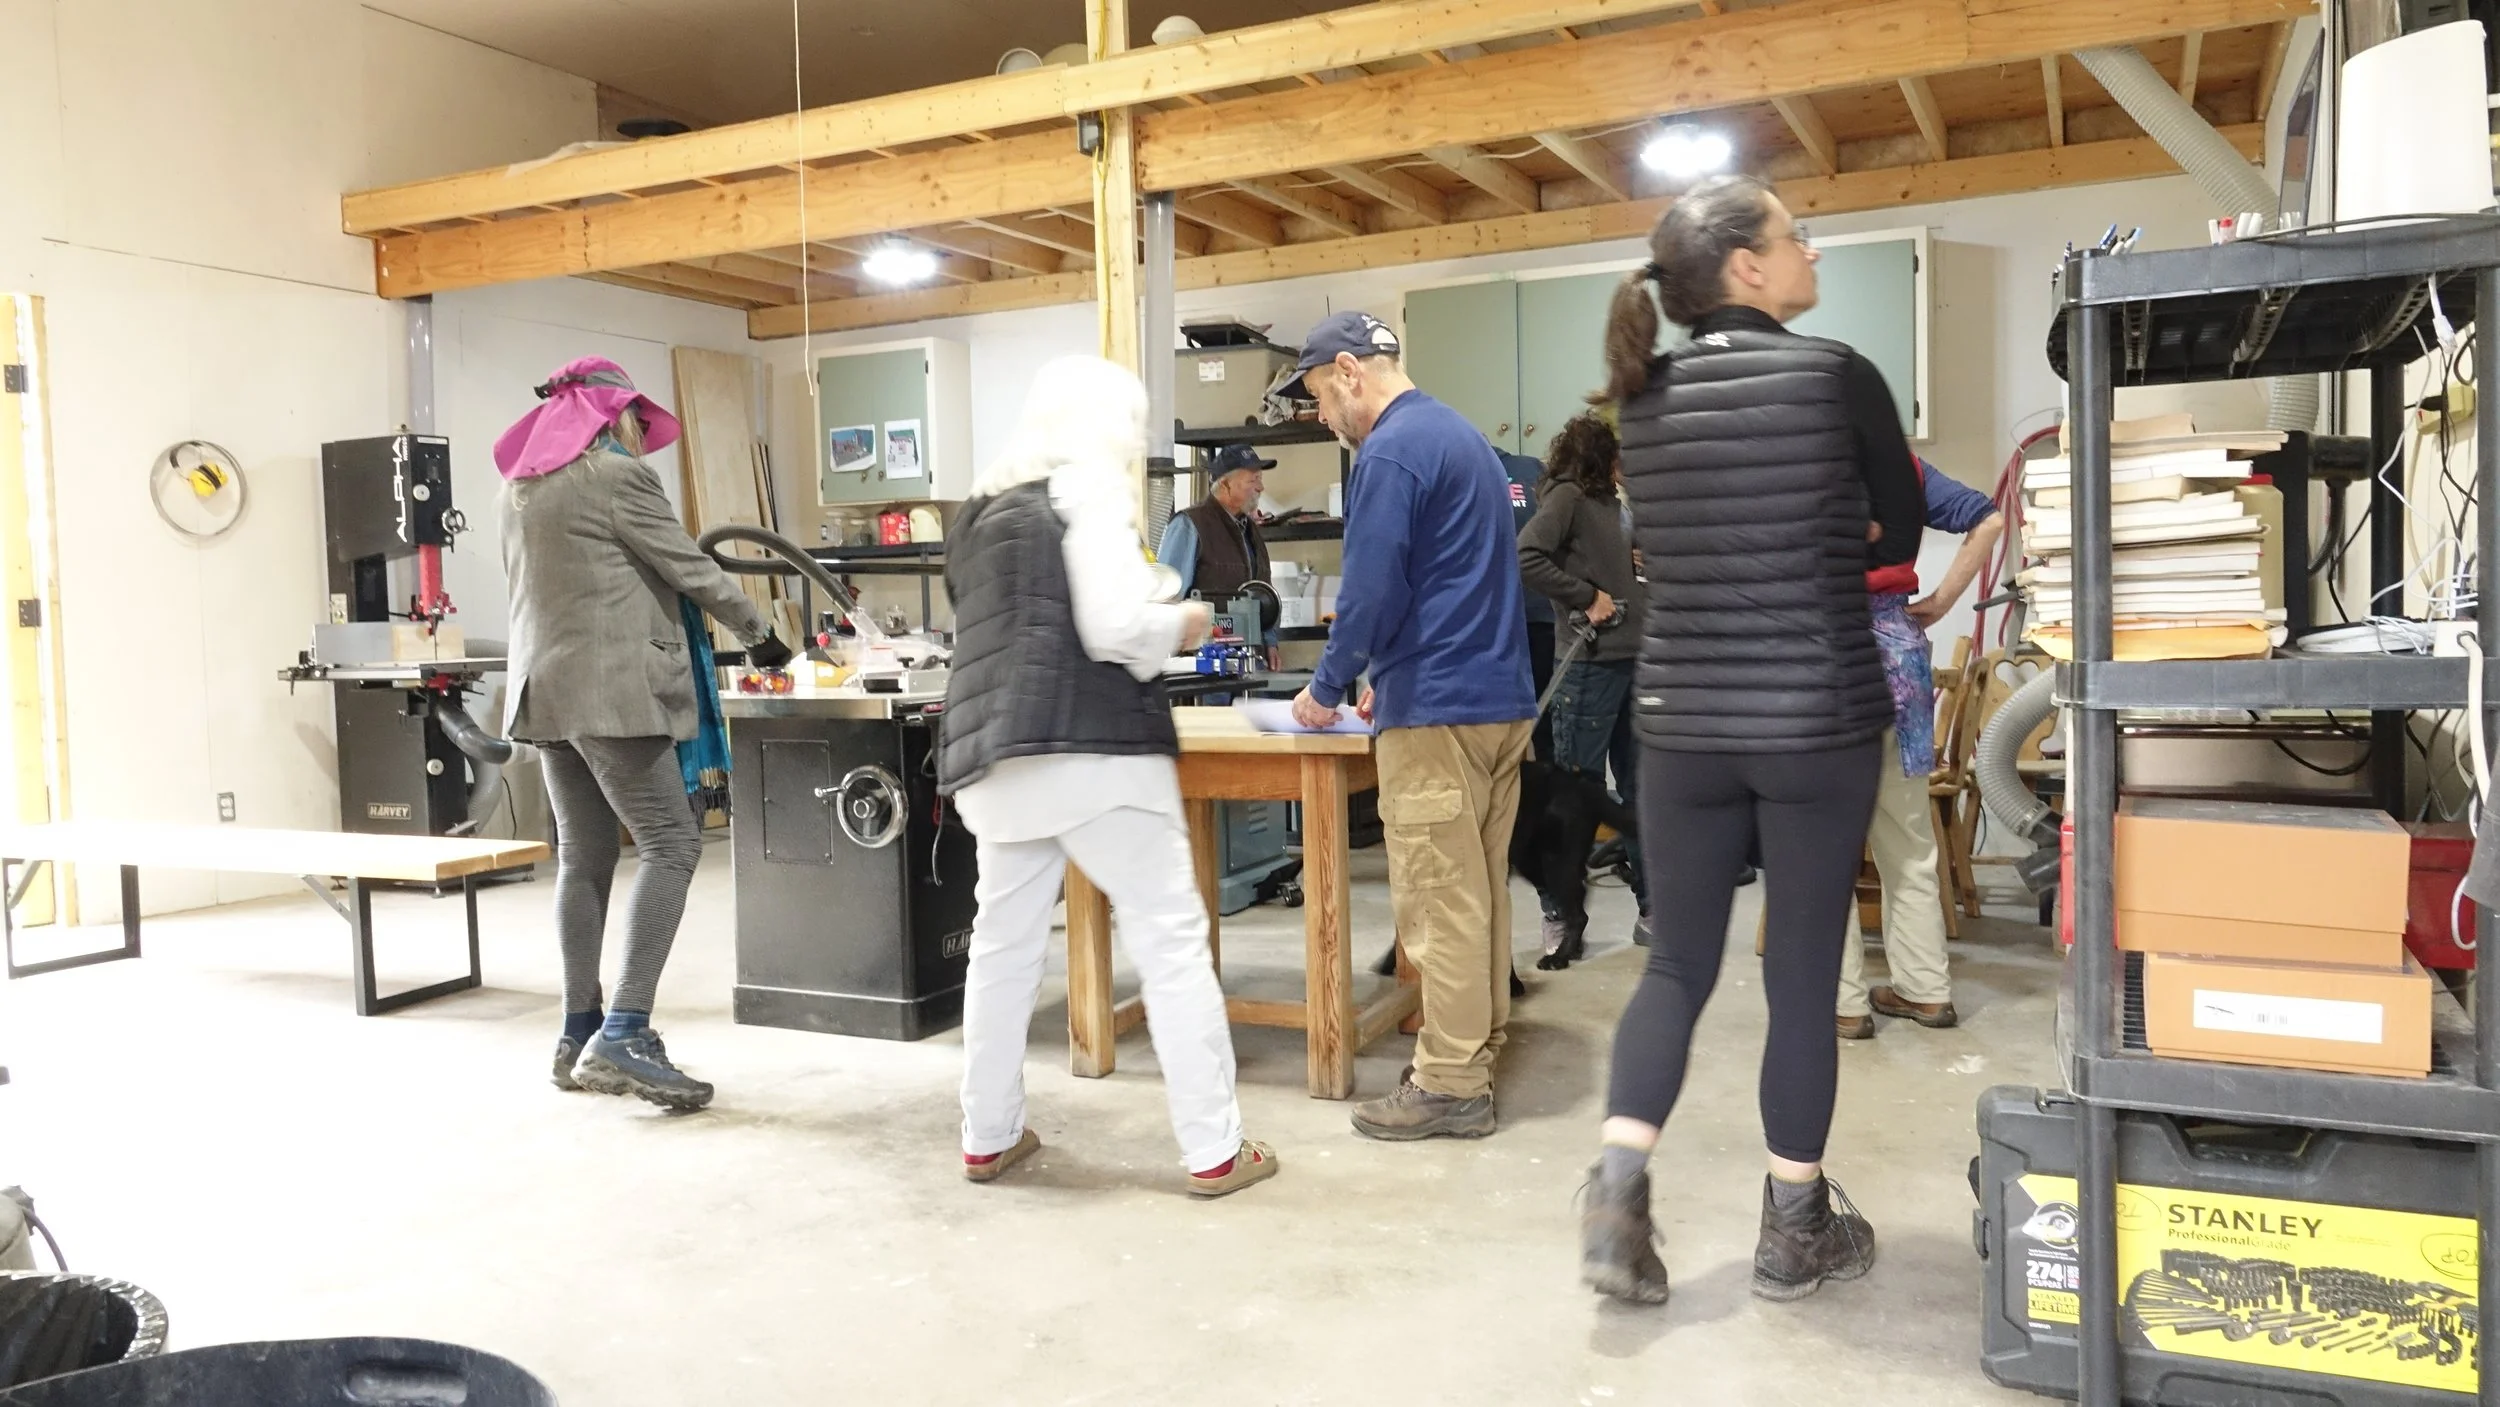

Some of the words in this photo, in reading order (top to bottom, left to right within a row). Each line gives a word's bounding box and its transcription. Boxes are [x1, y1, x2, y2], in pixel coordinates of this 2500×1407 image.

[392, 436, 407, 542] ALPHA
[370, 804, 409, 818] HARVEY
[2168, 1203, 2323, 1239] STANLEY
[2026, 1260, 2063, 1282] 274
